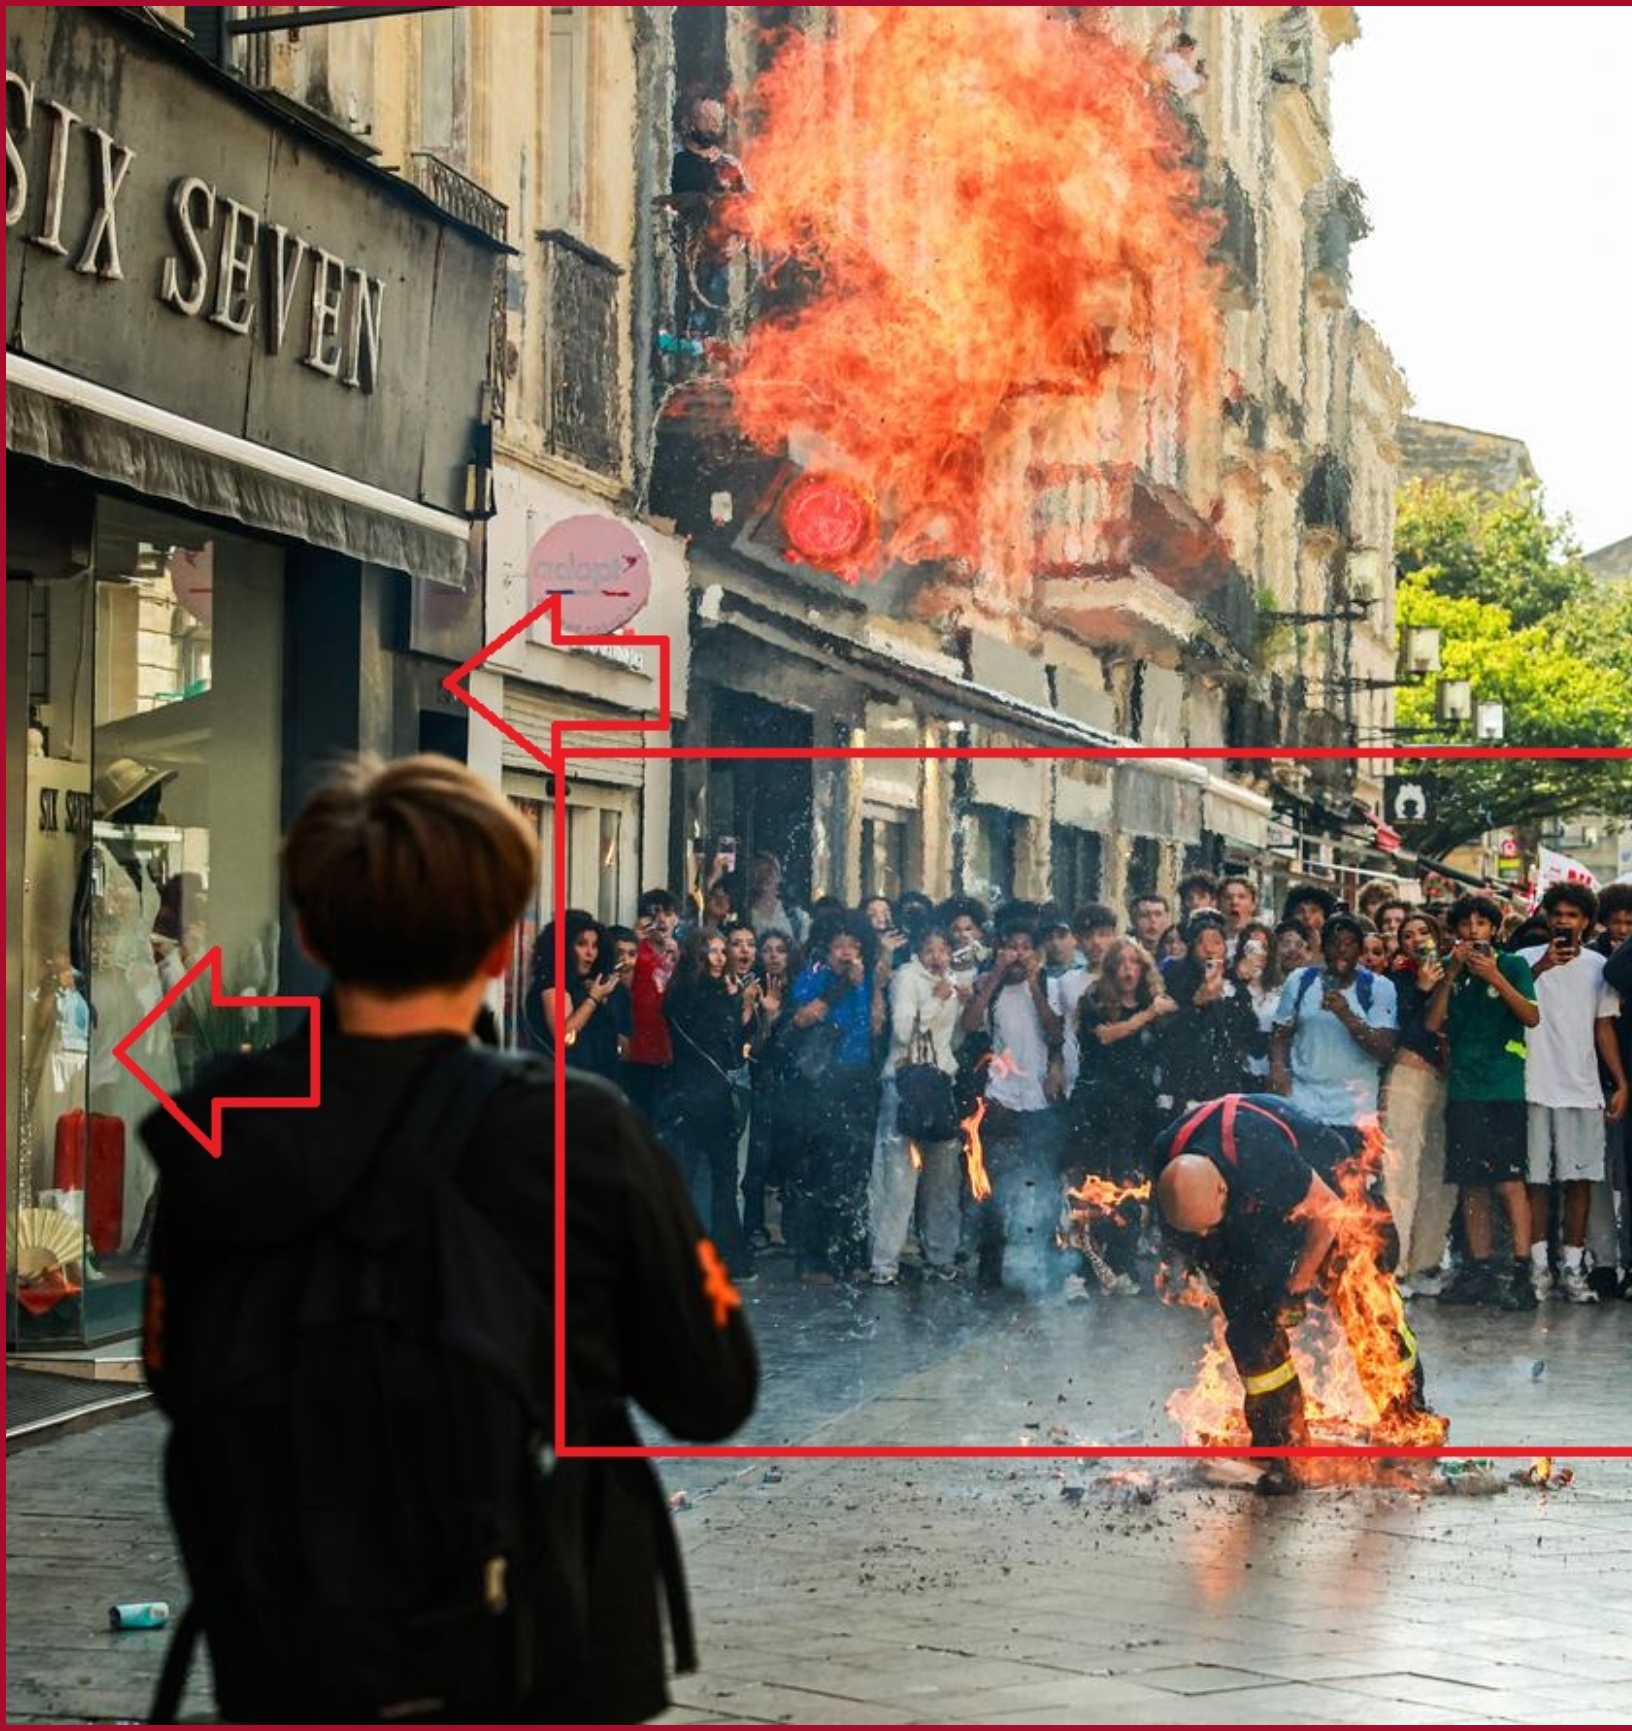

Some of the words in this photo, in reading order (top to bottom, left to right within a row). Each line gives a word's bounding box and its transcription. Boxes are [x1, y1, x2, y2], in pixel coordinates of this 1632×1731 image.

[6, 70, 136, 280] SIX
[160, 176, 386, 394] SEVEN
[39, 787, 58, 831] SIX
